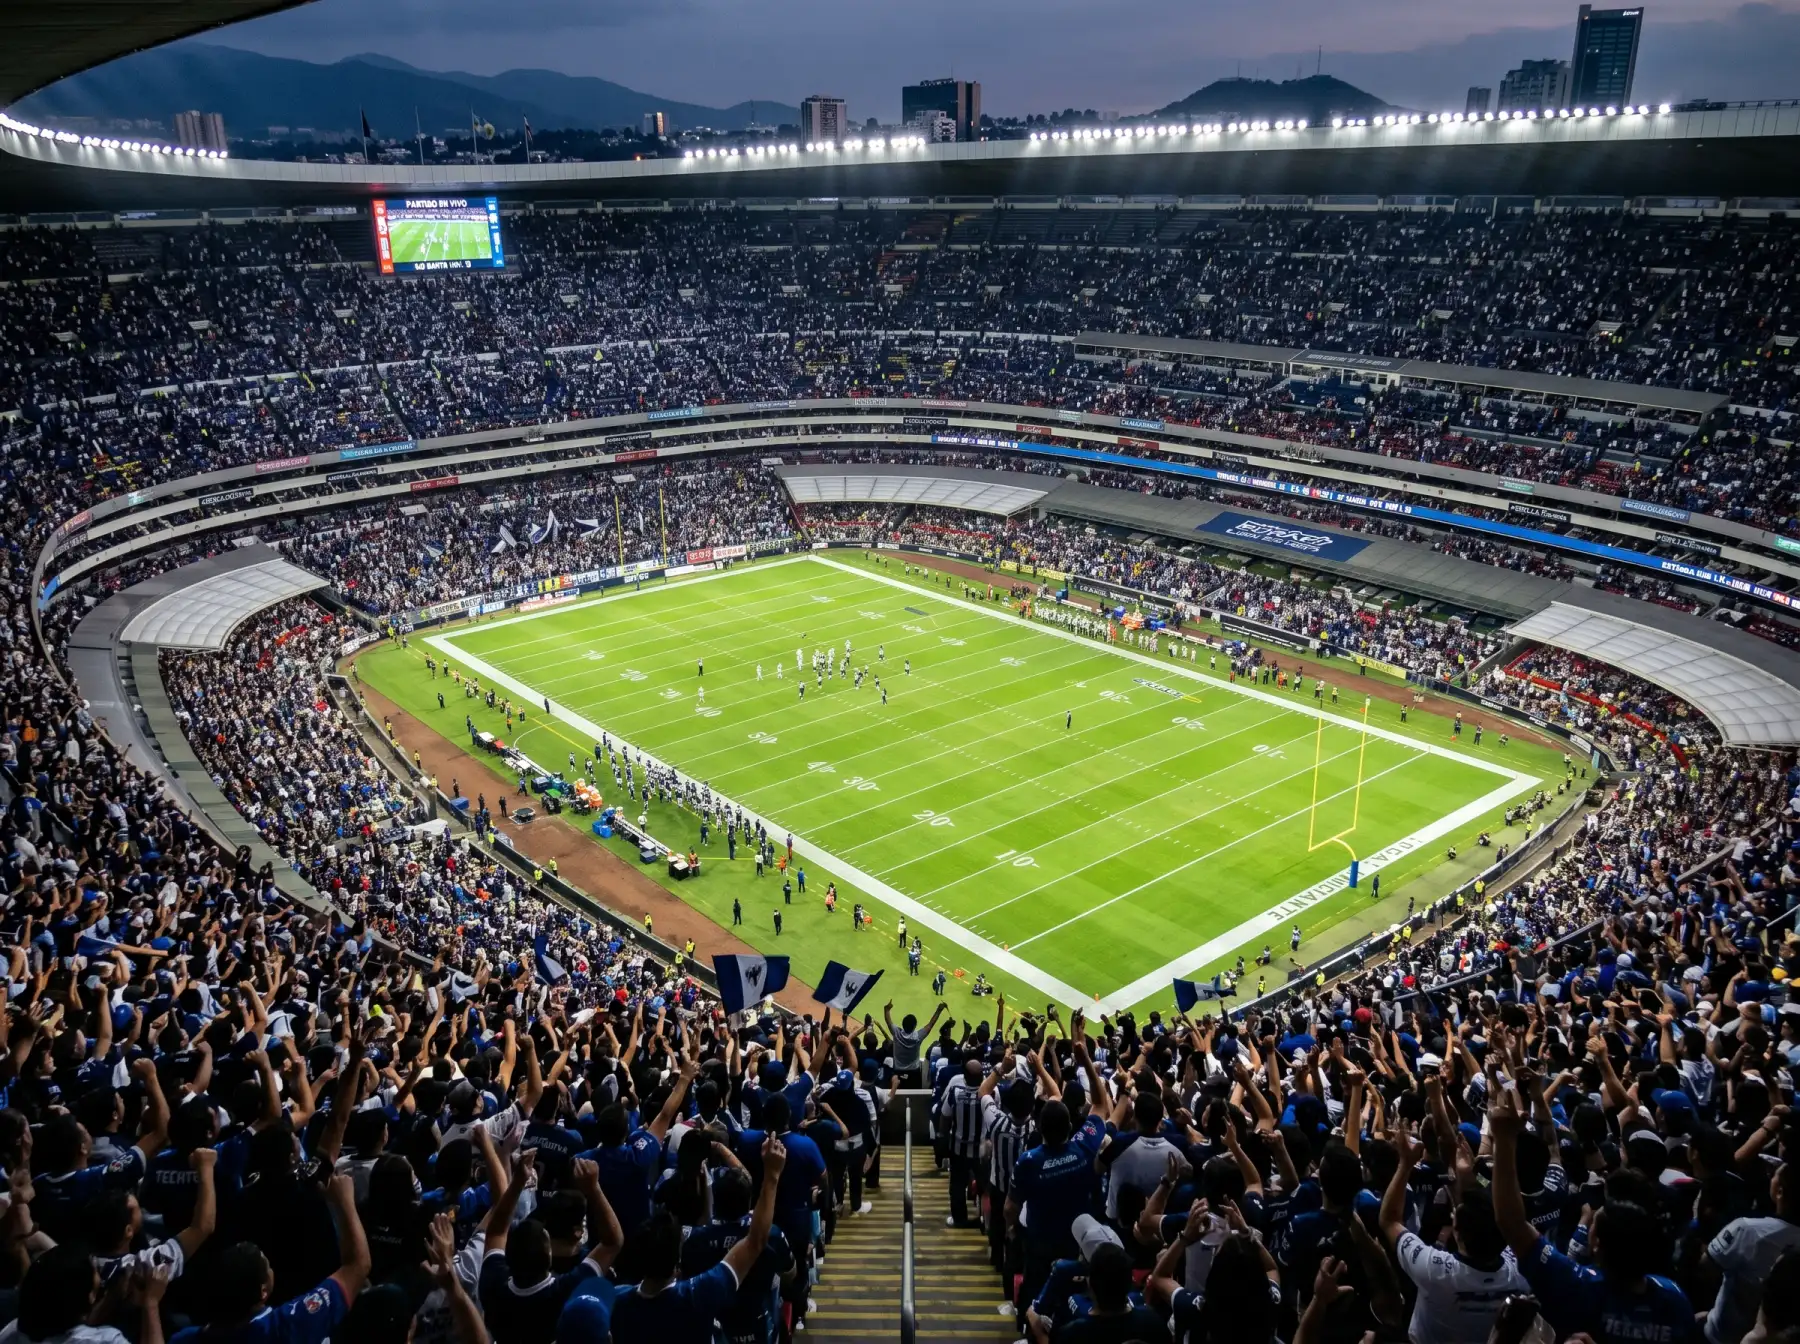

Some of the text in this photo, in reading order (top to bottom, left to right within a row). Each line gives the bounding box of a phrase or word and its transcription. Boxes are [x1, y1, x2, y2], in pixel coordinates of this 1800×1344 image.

[449, 199, 468, 208] VIVO
[911, 809, 952, 826] 20
[994, 849, 1036, 867] 10
